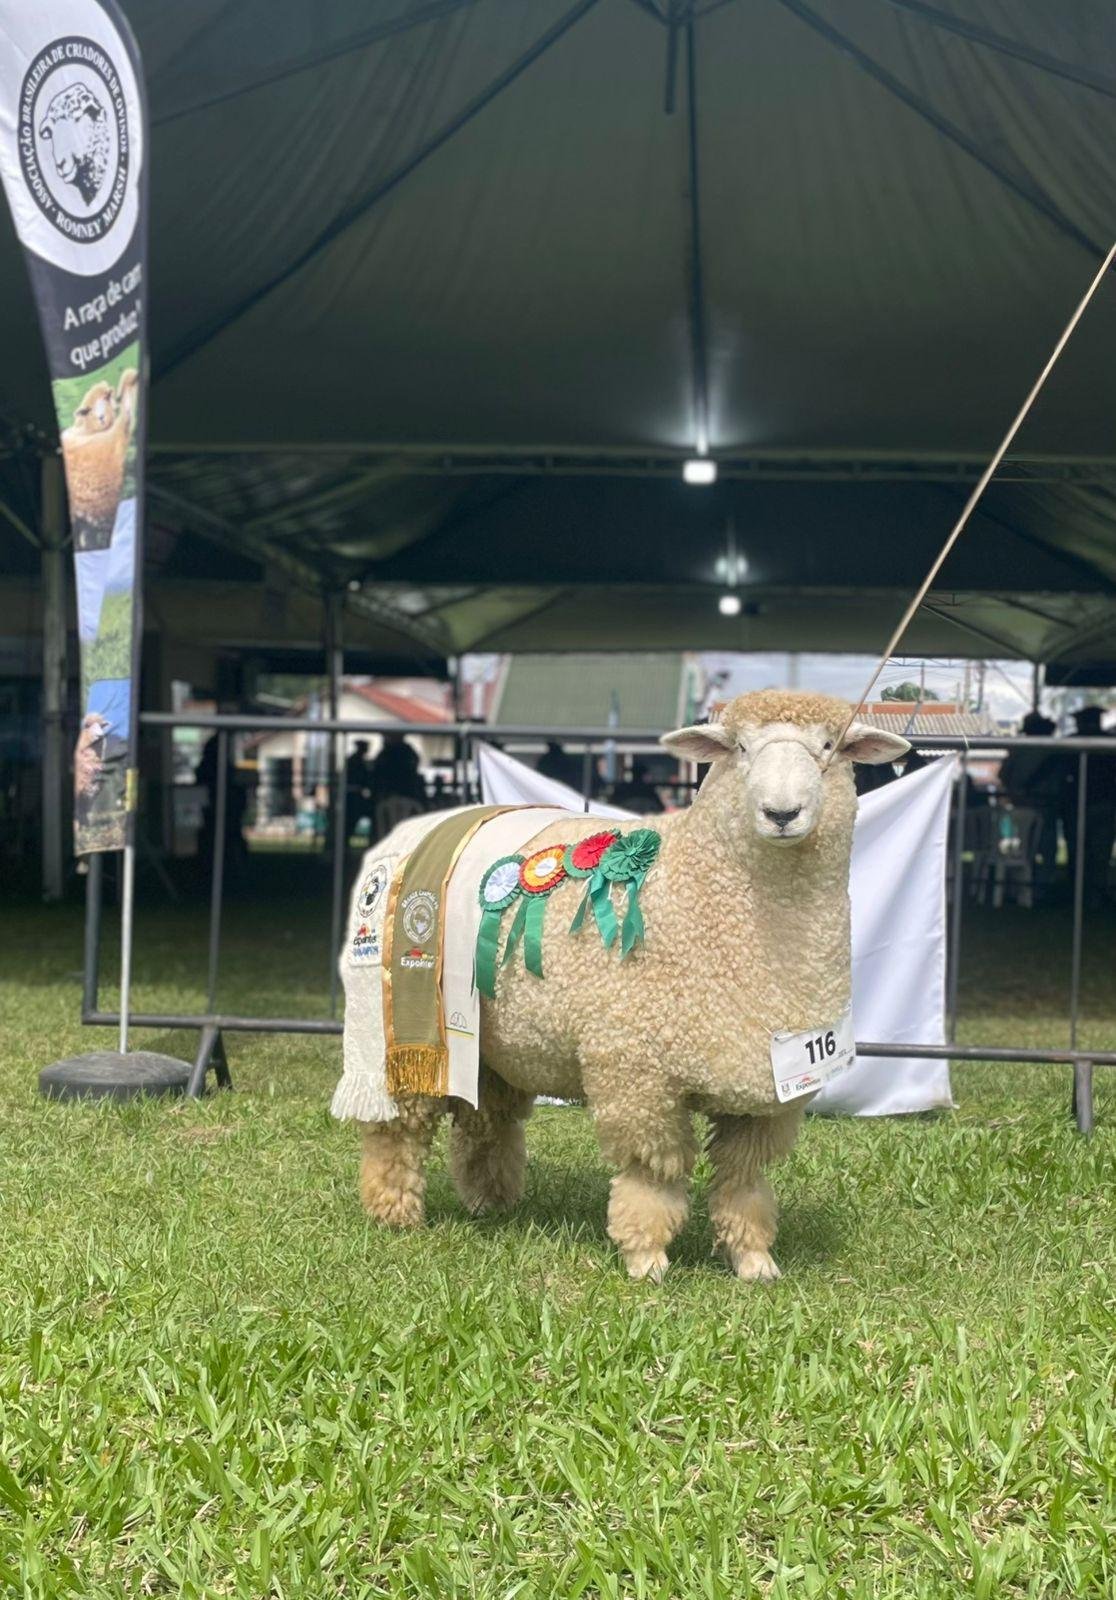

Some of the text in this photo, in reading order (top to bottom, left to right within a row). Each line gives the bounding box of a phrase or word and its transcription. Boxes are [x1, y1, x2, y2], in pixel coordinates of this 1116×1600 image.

[21, 42, 129, 211] ASSOCIAÇÃO BRASILEIRA DE CRIADORES DE OVINOS
[55, 166, 127, 239] ROMNEY MARSH
[63, 306, 79, 331] A
[78, 294, 108, 324] raça
[106, 280, 123, 306] de
[70, 339, 101, 371] que
[805, 1031, 836, 1064] 116
